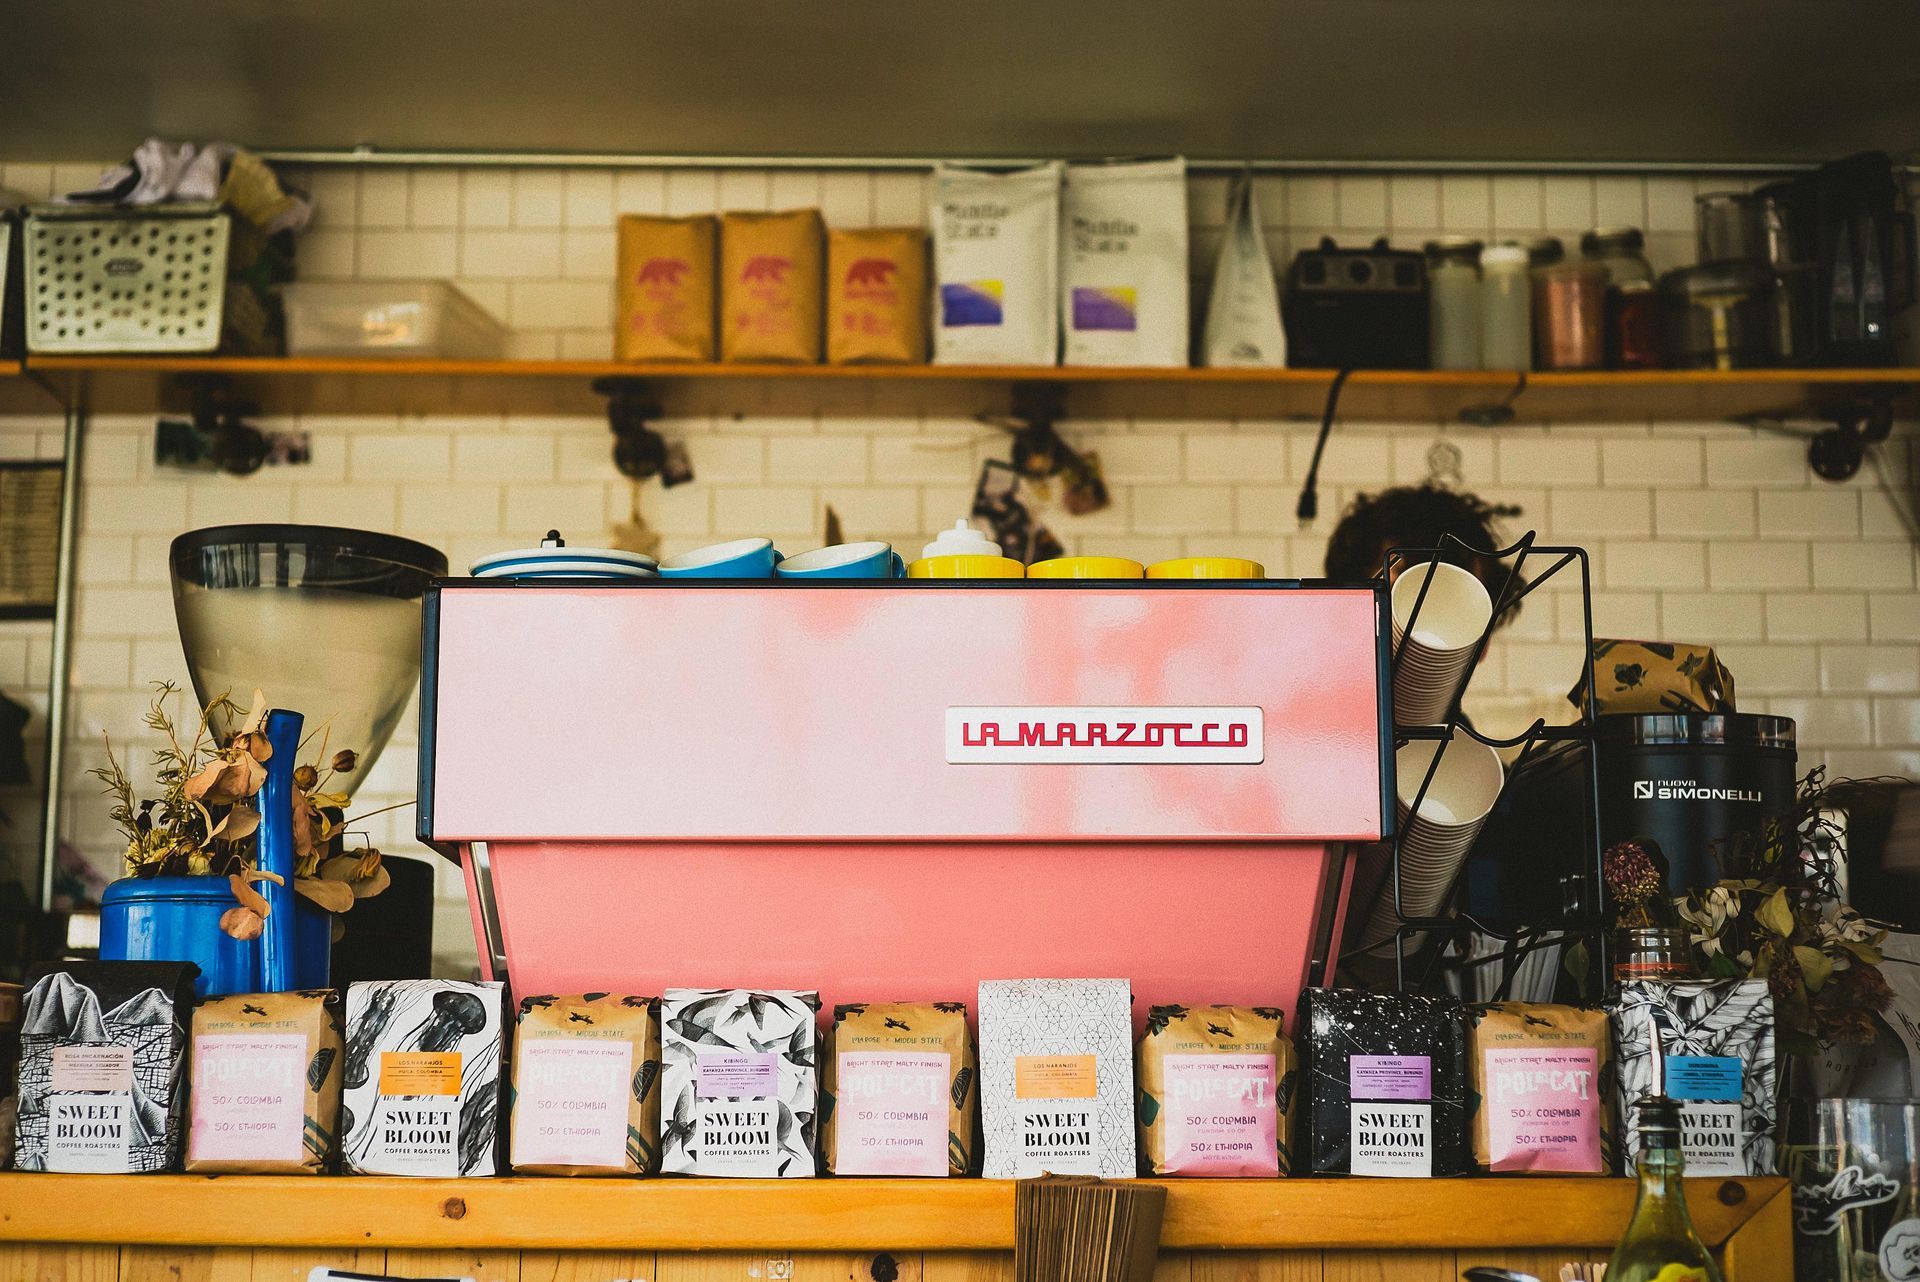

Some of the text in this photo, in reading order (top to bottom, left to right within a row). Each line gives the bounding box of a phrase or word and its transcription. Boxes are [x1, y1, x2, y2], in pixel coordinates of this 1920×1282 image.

[1019, 722, 1248, 747] MARZOCCO
[1658, 788, 1762, 802] SIMONELLI
[602, 1030, 625, 1038] STATE
[920, 1037, 944, 1045] STATE
[1564, 1032, 1586, 1040] STATE
[871, 1060, 893, 1068] START
[1495, 1070, 1591, 1103] POLECAT
[212, 1096, 282, 1105] 50% COLOMBIA
[537, 1100, 607, 1110] 50% COLOMBIA
[57, 1105, 122, 1120] SWEET
[385, 1111, 452, 1125] SWEET
[704, 1112, 770, 1127] SWEET
[858, 1111, 929, 1121] 50% COLOMBIA
[1511, 1108, 1581, 1118] 50% COLOMBIA
[214, 1122, 277, 1132] 50% ETHIOPIA
[1024, 1113, 1090, 1128] SWEET
[1186, 1116, 1257, 1125] 50% COLOMBIA
[1359, 1113, 1424, 1129] SWEET
[1681, 1114, 1735, 1129] WEET
[56, 1124, 122, 1139] BLOOM
[385, 1130, 451, 1144] BLOOM
[539, 1126, 601, 1136] 50% ETHIOPIA
[704, 1131, 770, 1145] BLOOM
[861, 1137, 924, 1146] 50% ETHIOPIA
[1025, 1132, 1090, 1147] BLOOM
[1359, 1132, 1424, 1147] BLOOM
[1515, 1135, 1578, 1144] 50% ETHIOPIA
[1683, 1133, 1735, 1147] LOOM
[1190, 1142, 1253, 1152] 50% ETHIOPIA
